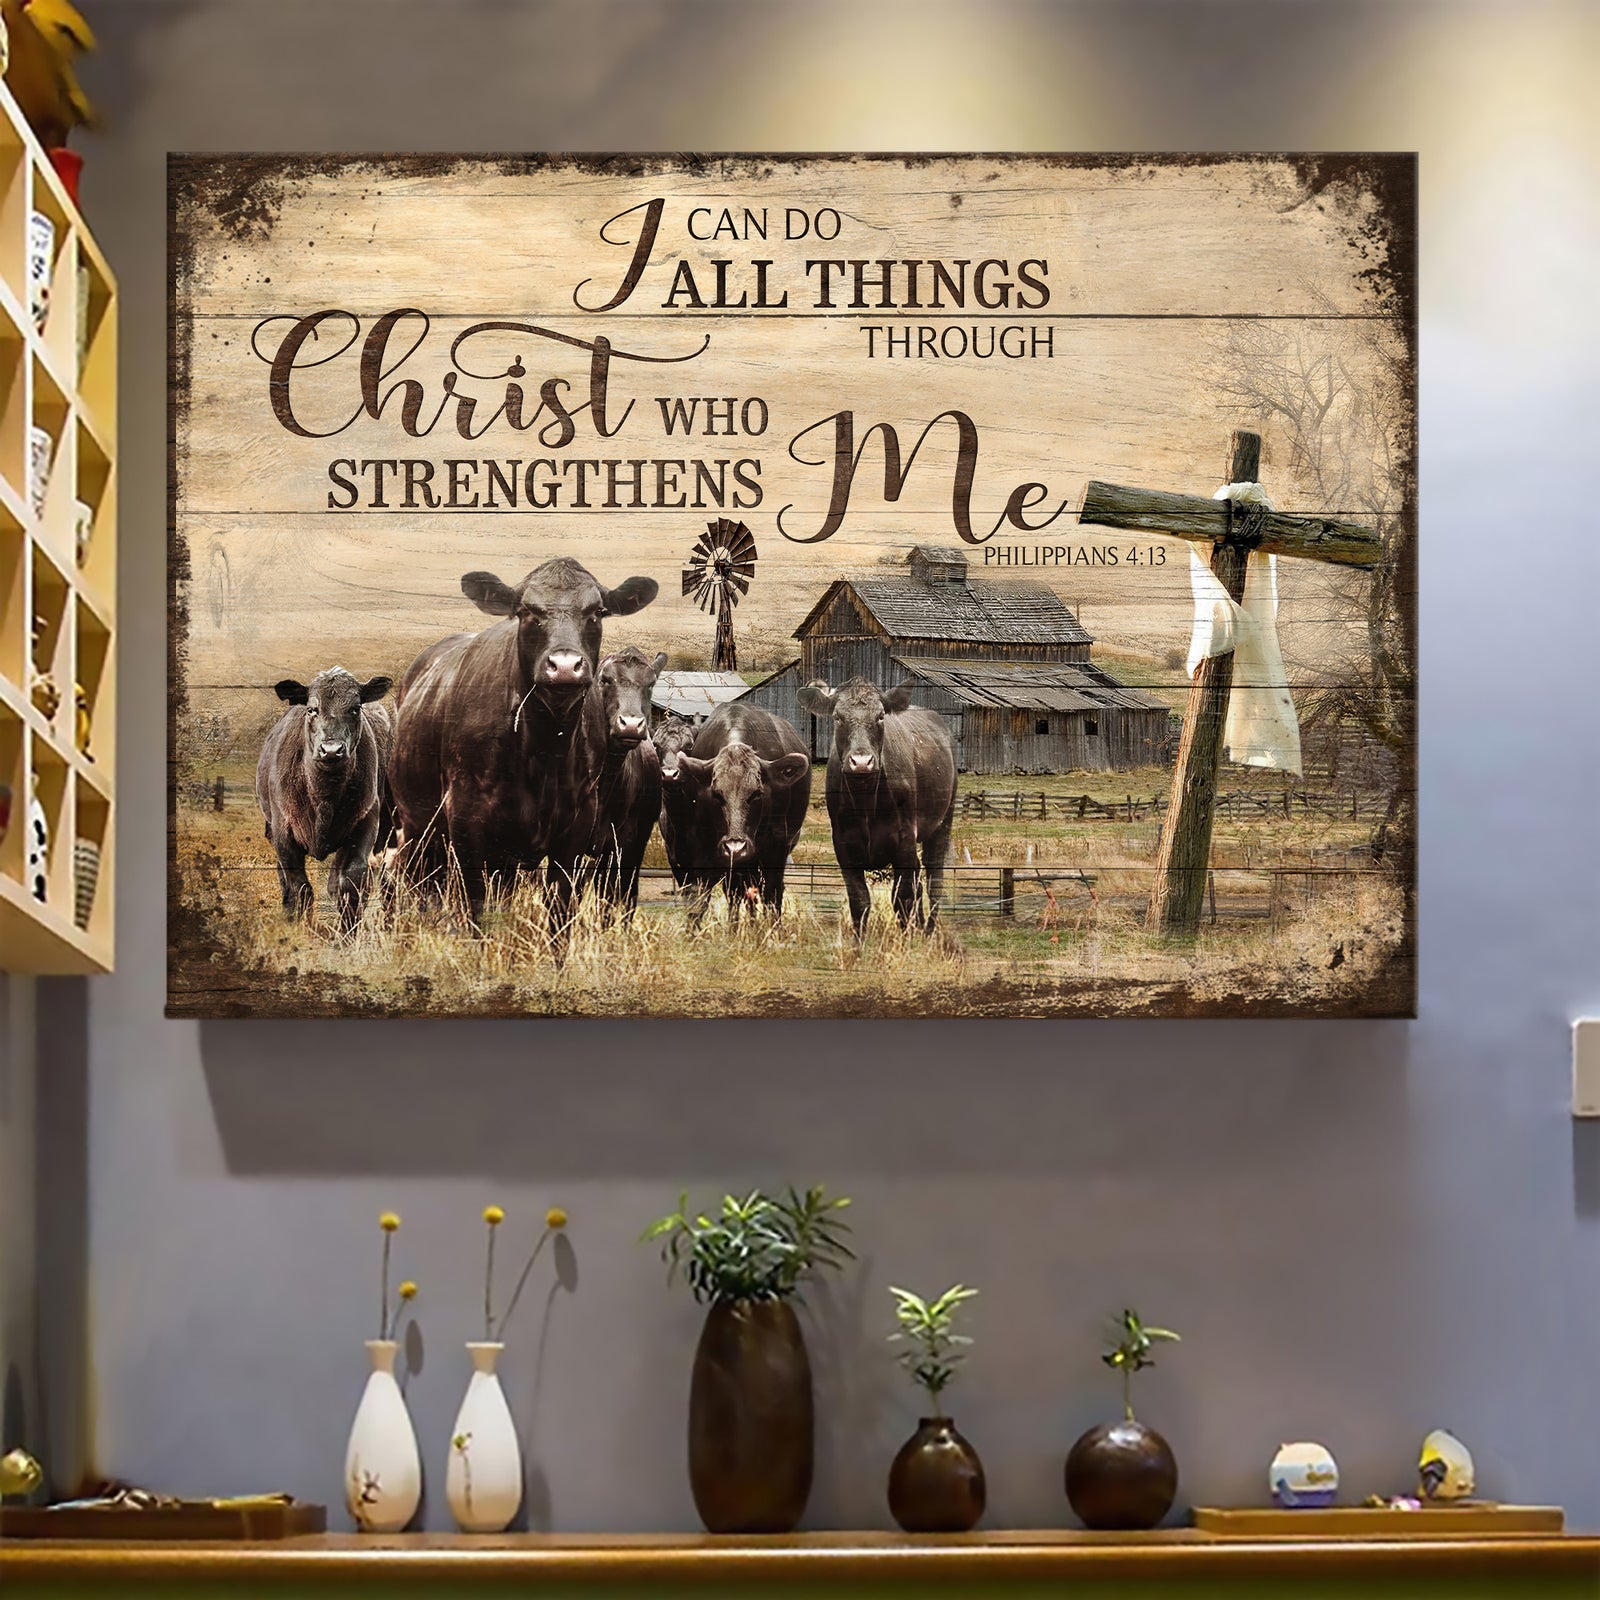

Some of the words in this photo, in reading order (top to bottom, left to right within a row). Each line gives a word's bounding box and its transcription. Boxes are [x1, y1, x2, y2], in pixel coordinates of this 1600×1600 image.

[573, 198, 666, 312] I
[687, 207, 768, 240] CAN
[784, 207, 842, 240] DO
[661, 259, 788, 309] ALL
[806, 258, 1051, 309] THINGS
[251, 308, 711, 449] Christ
[655, 396, 769, 436] WHO
[860, 326, 1055, 359] THROUGH
[327, 458, 764, 509] STRENGTHENS
[776, 410, 1069, 545] Me
[984, 546, 1119, 566] PHILIPPIANS
[1126, 546, 1167, 566] 4:13
